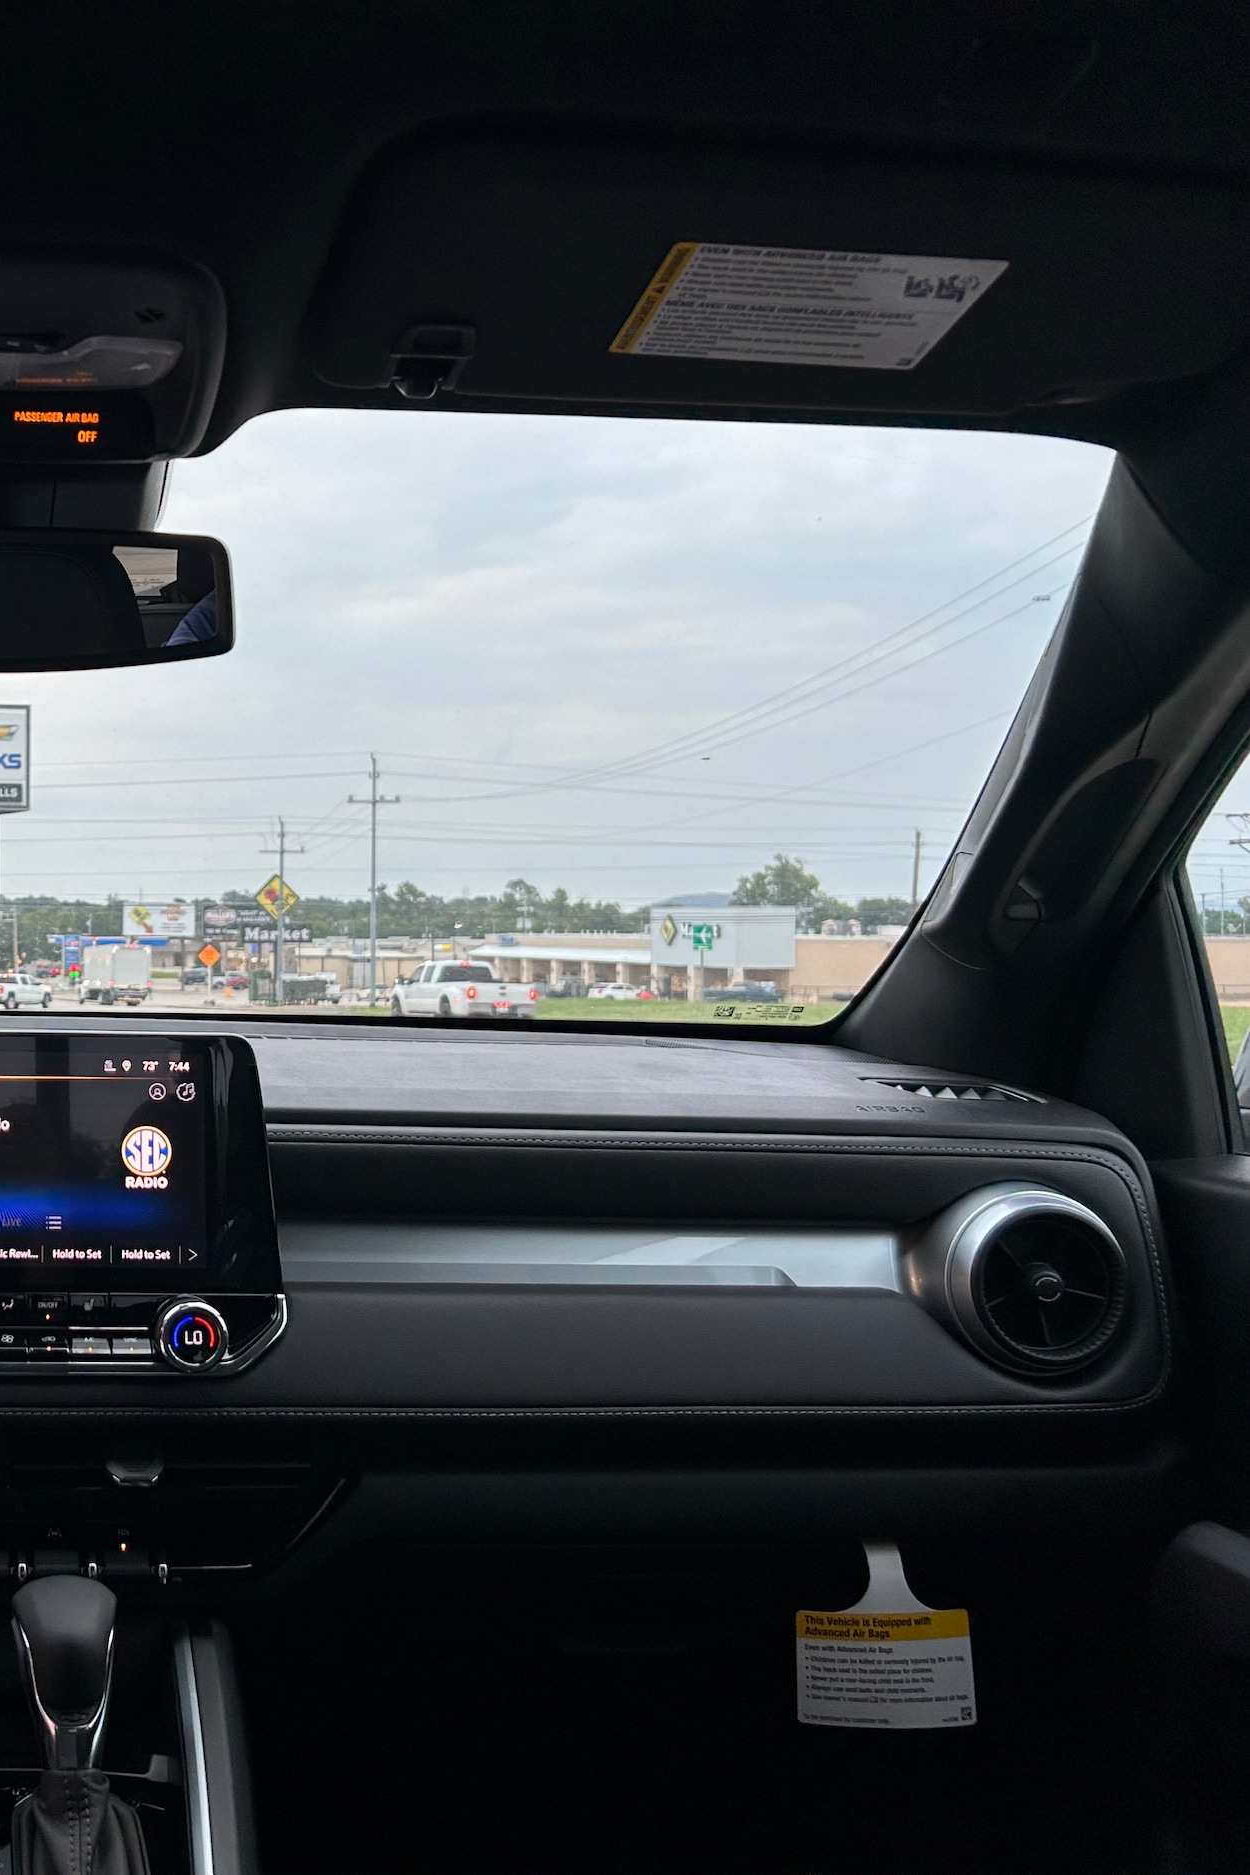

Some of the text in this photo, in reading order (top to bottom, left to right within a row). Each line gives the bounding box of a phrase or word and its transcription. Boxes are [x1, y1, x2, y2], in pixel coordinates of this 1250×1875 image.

[14, 411, 99, 423] PASSENGER AIR BAG
[78, 430, 98, 443] OFF
[168, 1061, 191, 1072] 7:44
[856, 1105, 926, 1114] AIRBAG
[125, 1130, 169, 1172] SEC
[124, 1176, 170, 1190] RADIO
[52, 1248, 103, 1260] Hold to Set
[121, 1248, 171, 1260] Hold to Set
[184, 1329, 204, 1345] LO
[805, 1614, 932, 1629] This Vehicle is Equipped with
[805, 1626, 890, 1640] Advanced Air Bags
